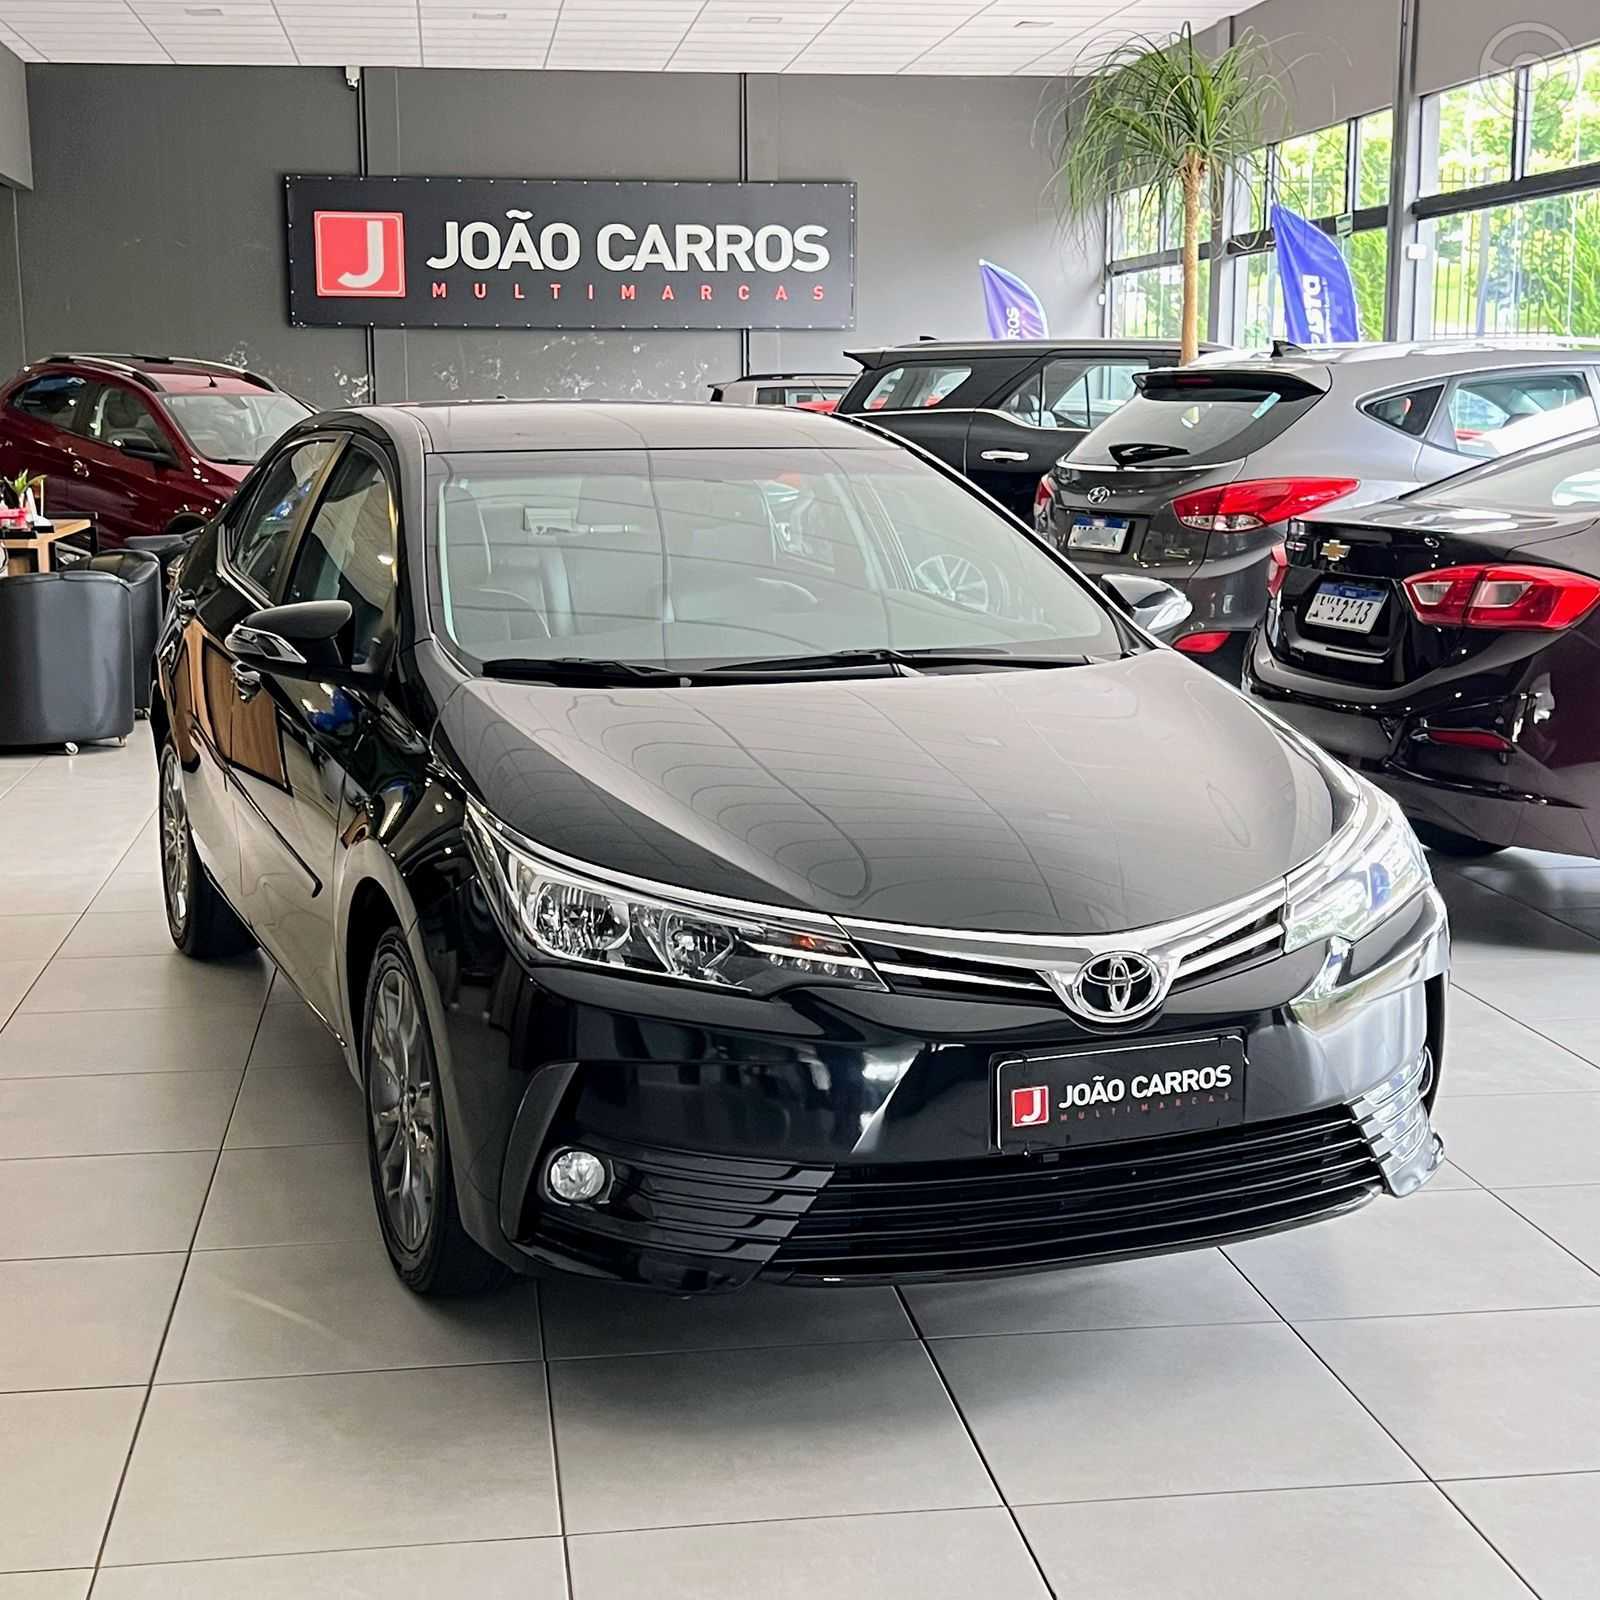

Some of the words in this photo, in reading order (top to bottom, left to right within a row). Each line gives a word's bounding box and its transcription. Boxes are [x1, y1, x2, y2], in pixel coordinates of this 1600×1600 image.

[337, 220, 383, 288] J
[426, 209, 581, 271] JOÃO
[596, 224, 830, 272] CARROS
[432, 282, 827, 300] MULTIMARCAS
[1058, 1075, 1125, 1109] JOÃO
[1131, 1064, 1232, 1098] CARROS
[1020, 1090, 1043, 1122] J
[1060, 1092, 1230, 1121] MULTIMARCAS
